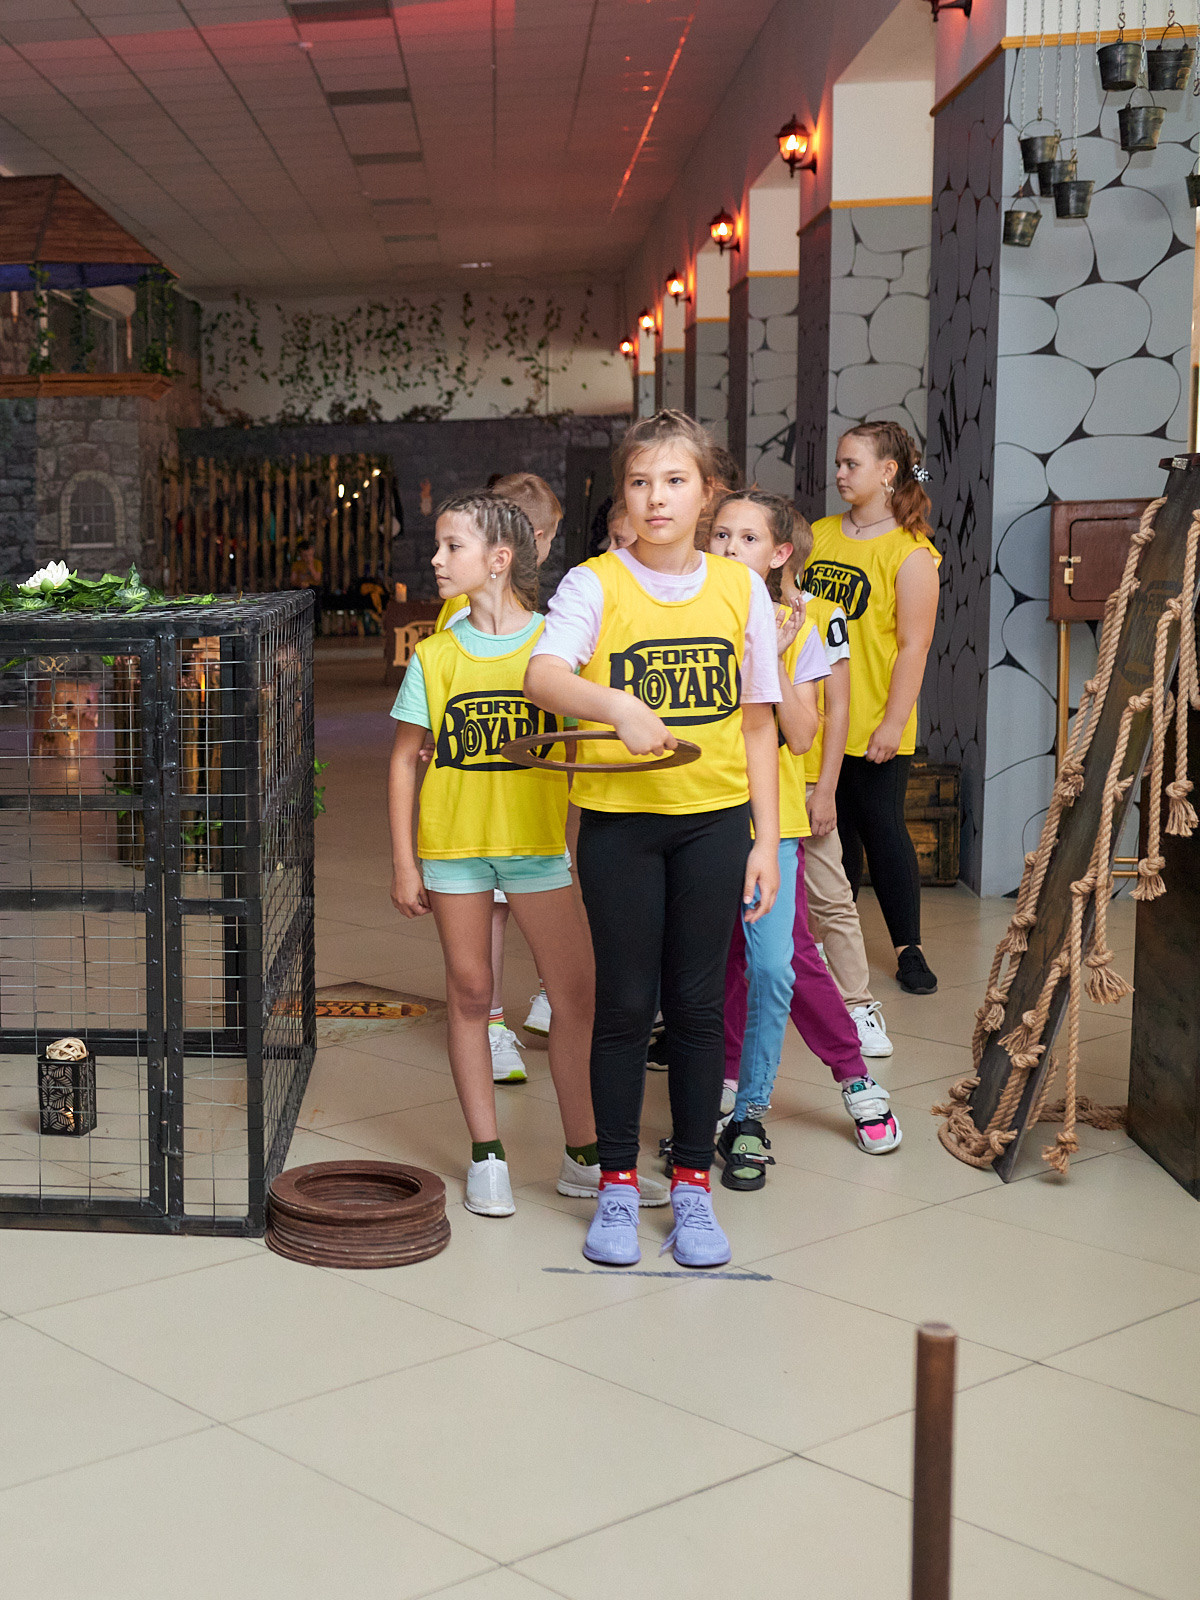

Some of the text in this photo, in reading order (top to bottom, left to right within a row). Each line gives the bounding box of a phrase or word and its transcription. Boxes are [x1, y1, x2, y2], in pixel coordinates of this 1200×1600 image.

[815, 567, 851, 581] FORT
[647, 648, 714, 666] FORT
[609, 648, 742, 711] BOYARD
[465, 701, 526, 717] FORT
